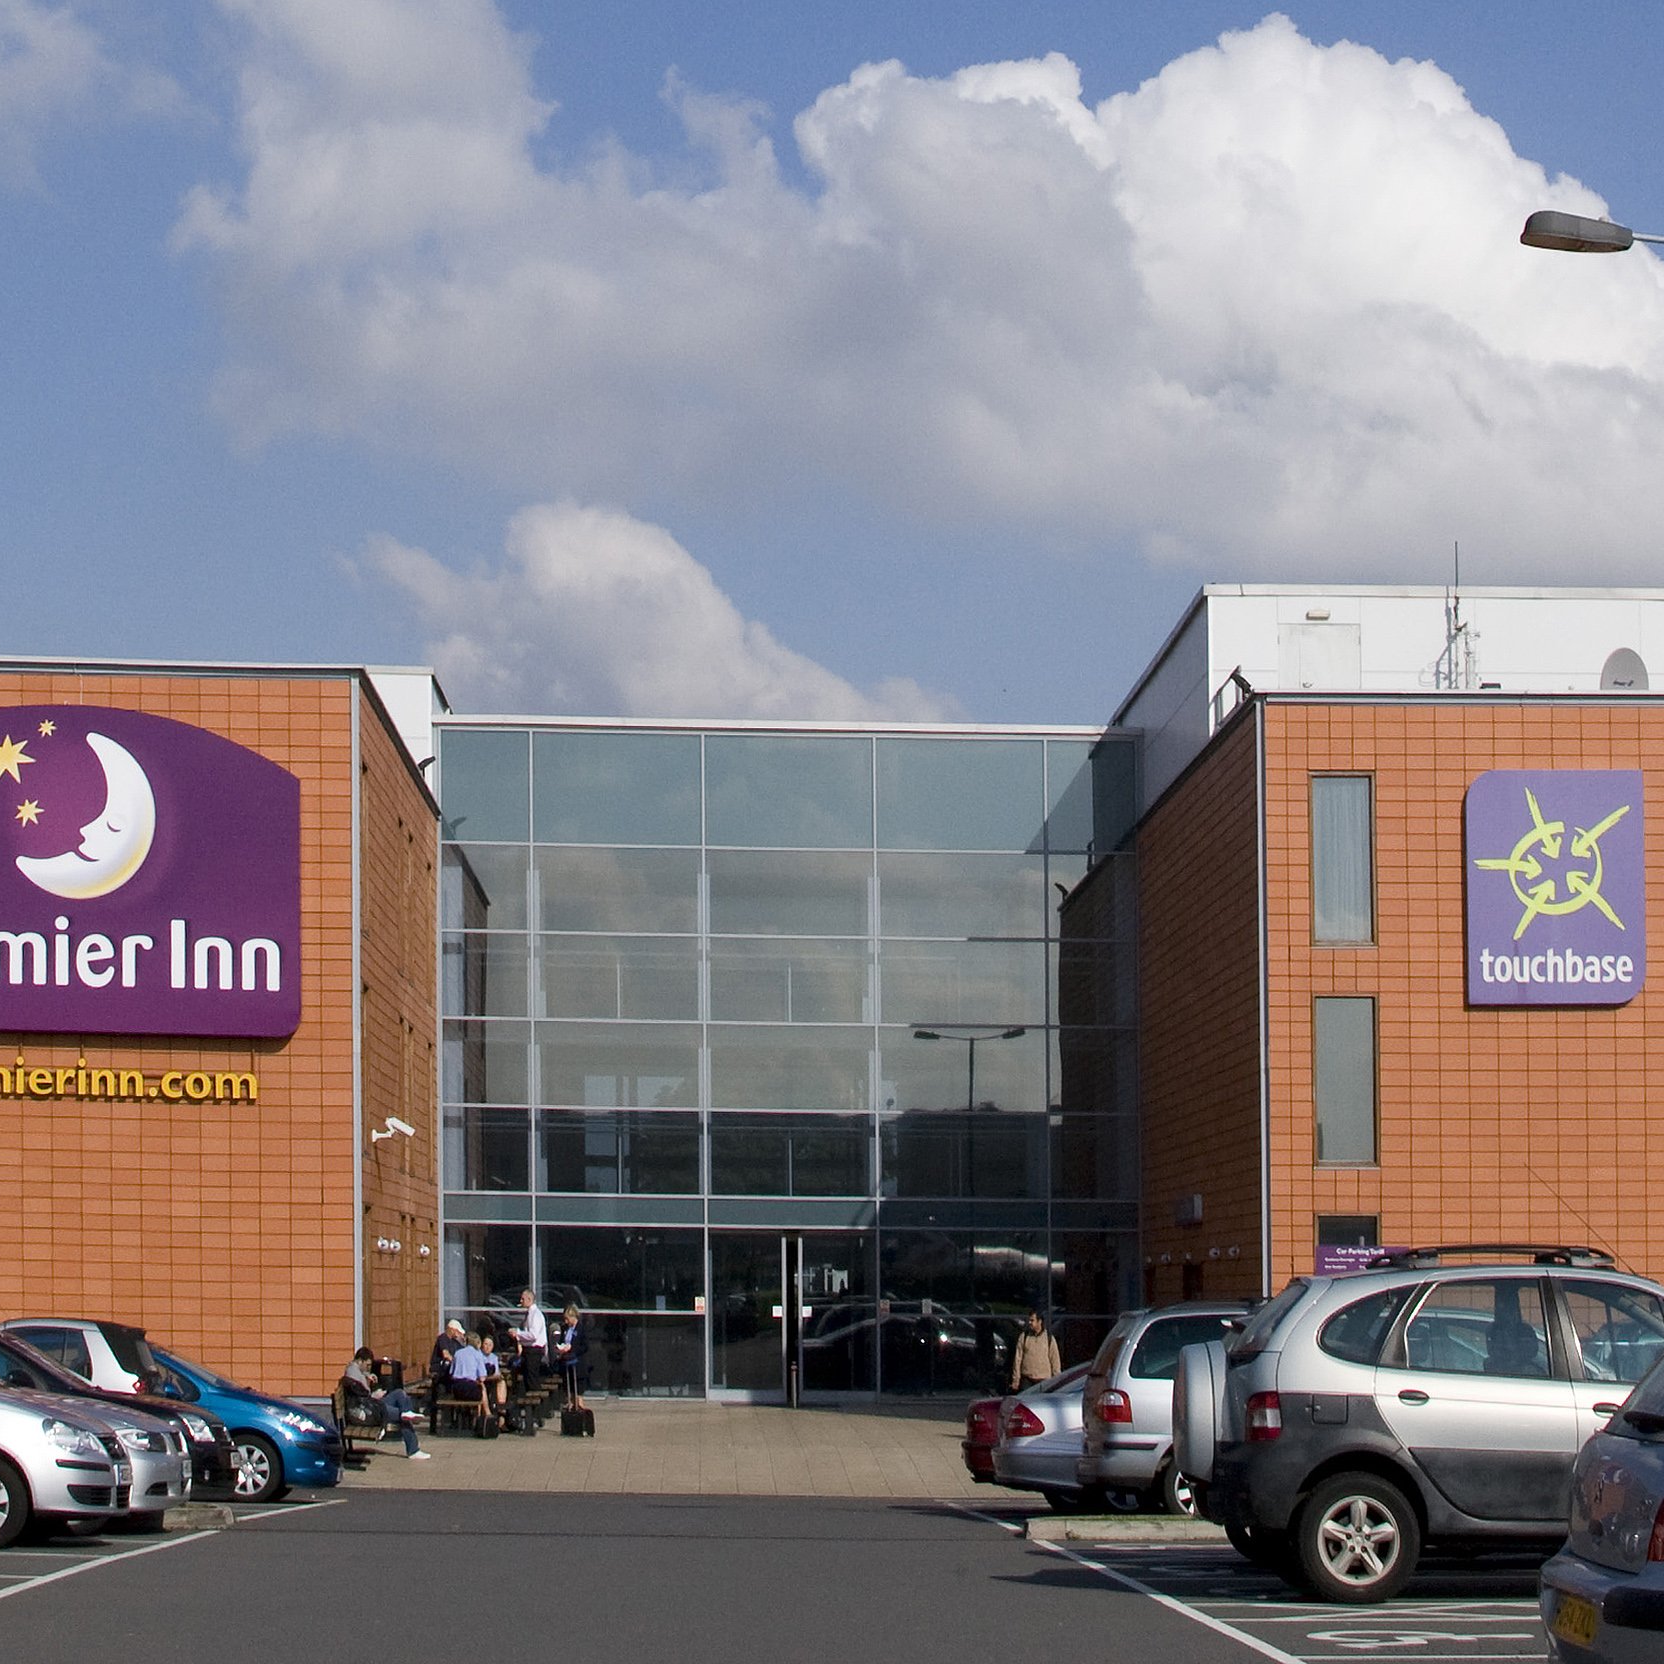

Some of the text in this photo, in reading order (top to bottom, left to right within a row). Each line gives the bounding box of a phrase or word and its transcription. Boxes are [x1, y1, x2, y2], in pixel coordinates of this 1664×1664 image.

[170, 919, 281, 992] Inn
[1480, 948, 1633, 983] touchbase
[1348, 1248, 1369, 1256] Parking
